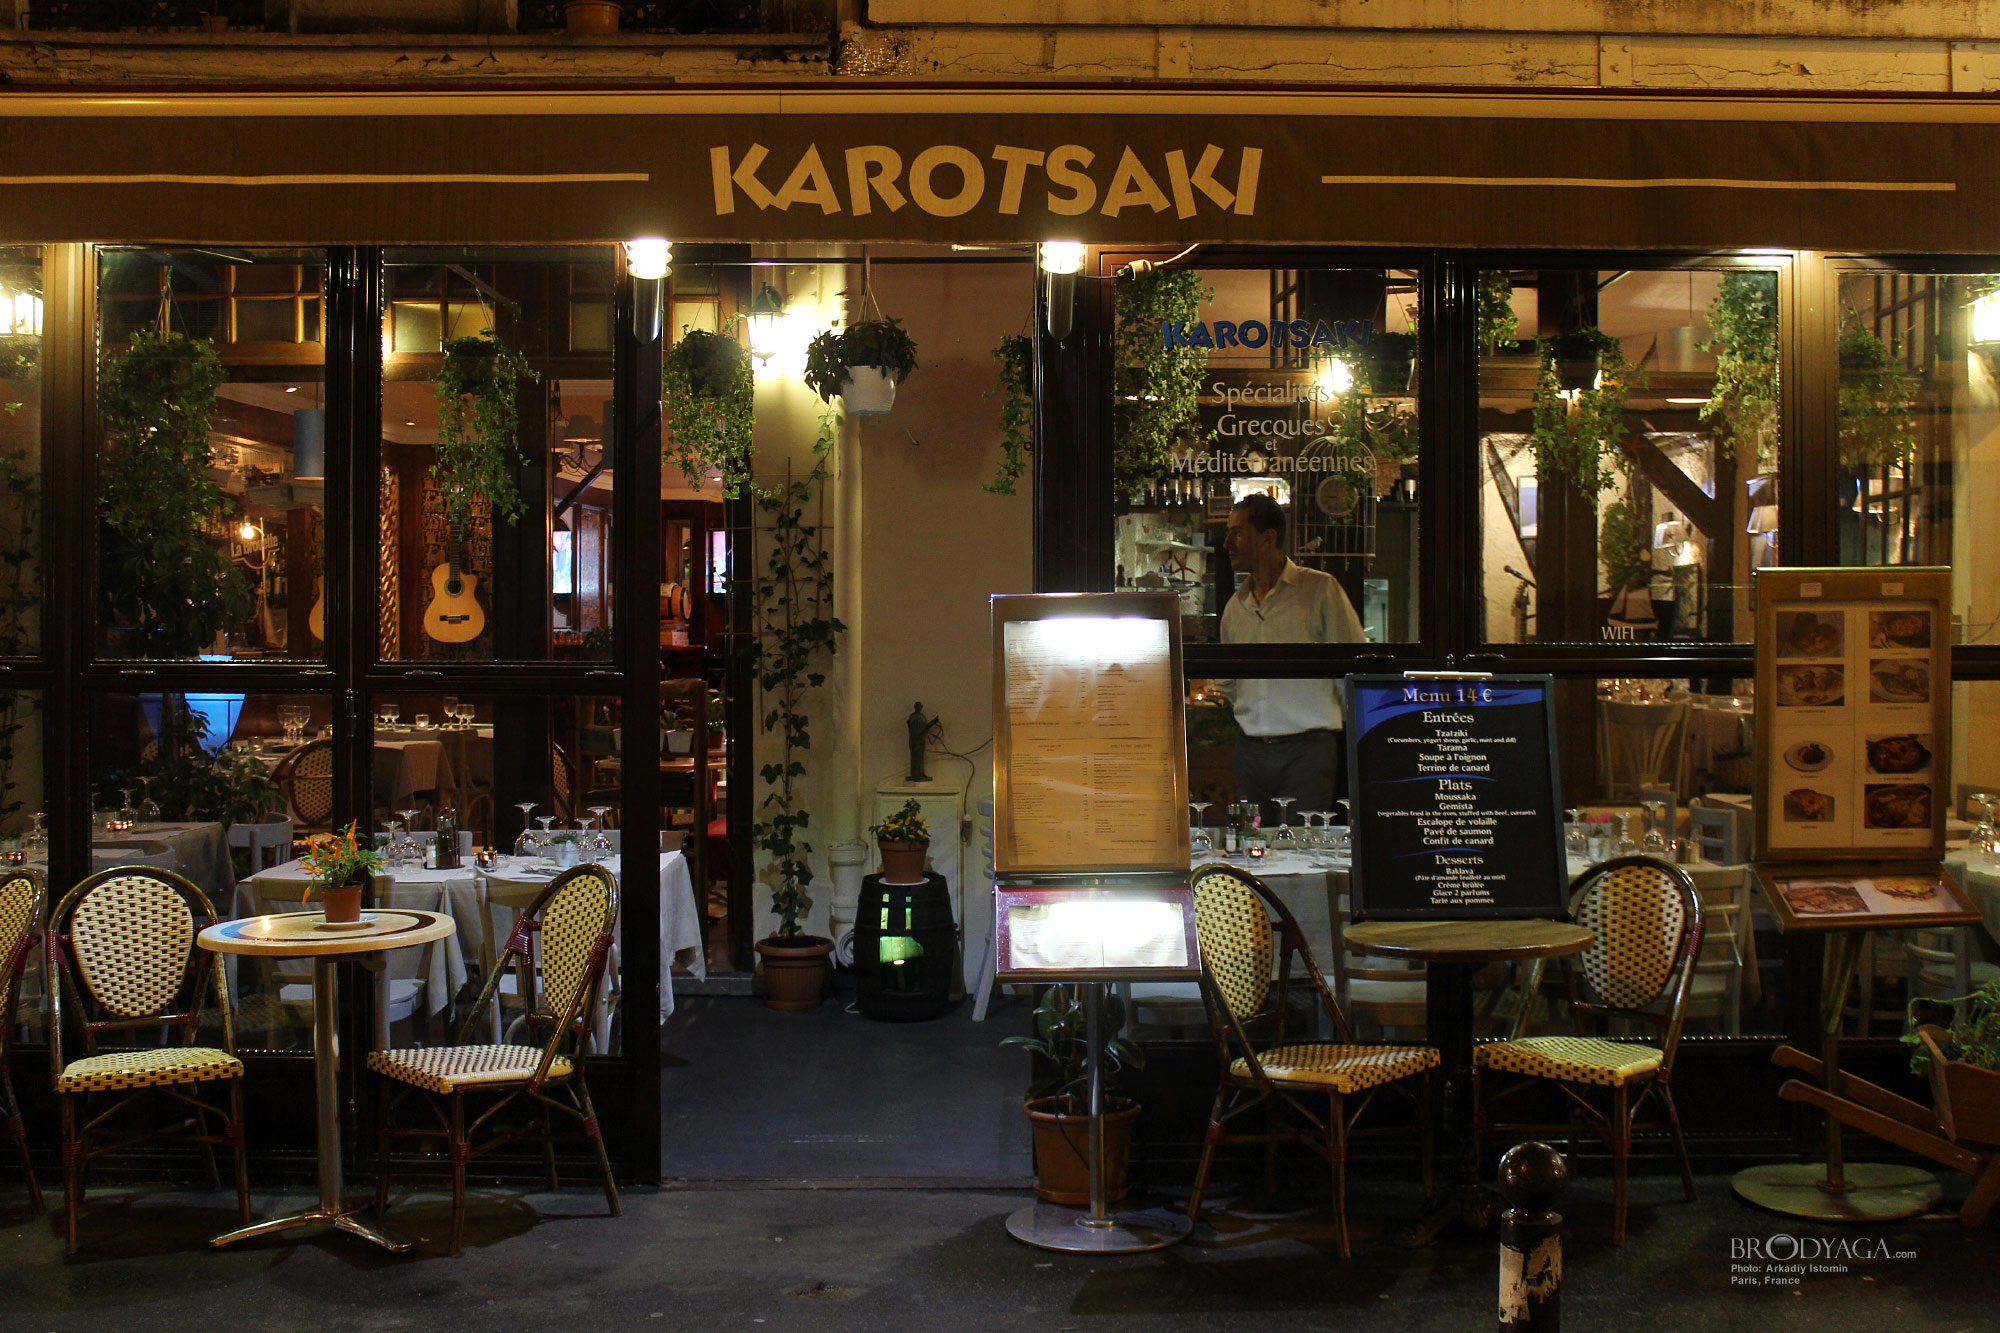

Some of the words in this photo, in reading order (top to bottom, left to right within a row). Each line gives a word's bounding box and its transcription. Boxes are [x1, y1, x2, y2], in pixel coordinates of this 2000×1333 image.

[709, 142, 1263, 220] KAROTSAKI
[1161, 319, 1375, 350] KAROTSAKI
[1211, 379, 1331, 411] Spécialités
[1217, 414, 1326, 438] Grecques
[1265, 438, 1278, 451] et
[230, 541, 243, 558] La
[1601, 626, 1635, 640] WIFI
[1402, 687, 1451, 702] Menu
[1457, 687, 1478, 702] 14
[1482, 688, 1493, 703] €
[1422, 711, 1475, 723] Entrées
[1435, 729, 1468, 737] Tzatziki
[1419, 753, 1445, 762] Soupe
[1446, 753, 1452, 761] à
[1454, 753, 1487, 762] l'oignon
[1438, 779, 1473, 791] Plats
[1439, 802, 1473, 811] Gemista
[1417, 818, 1453, 827] Escalope
[1468, 818, 1498, 826] volaille
[1423, 827, 1445, 835] Pavé
[1446, 827, 1457, 835] de
[1423, 837, 1450, 845] Confit
[1452, 837, 1463, 845] de
[1464, 837, 1494, 845] canard
[1435, 855, 1484, 865] Desserts
[1446, 867, 1474, 875] Baklava
[1437, 881, 1461, 889] Crème
[1462, 881, 1485, 889] brûlée
[1460, 889, 1490, 897] parfums
[1464, 898, 1495, 906] pommes
